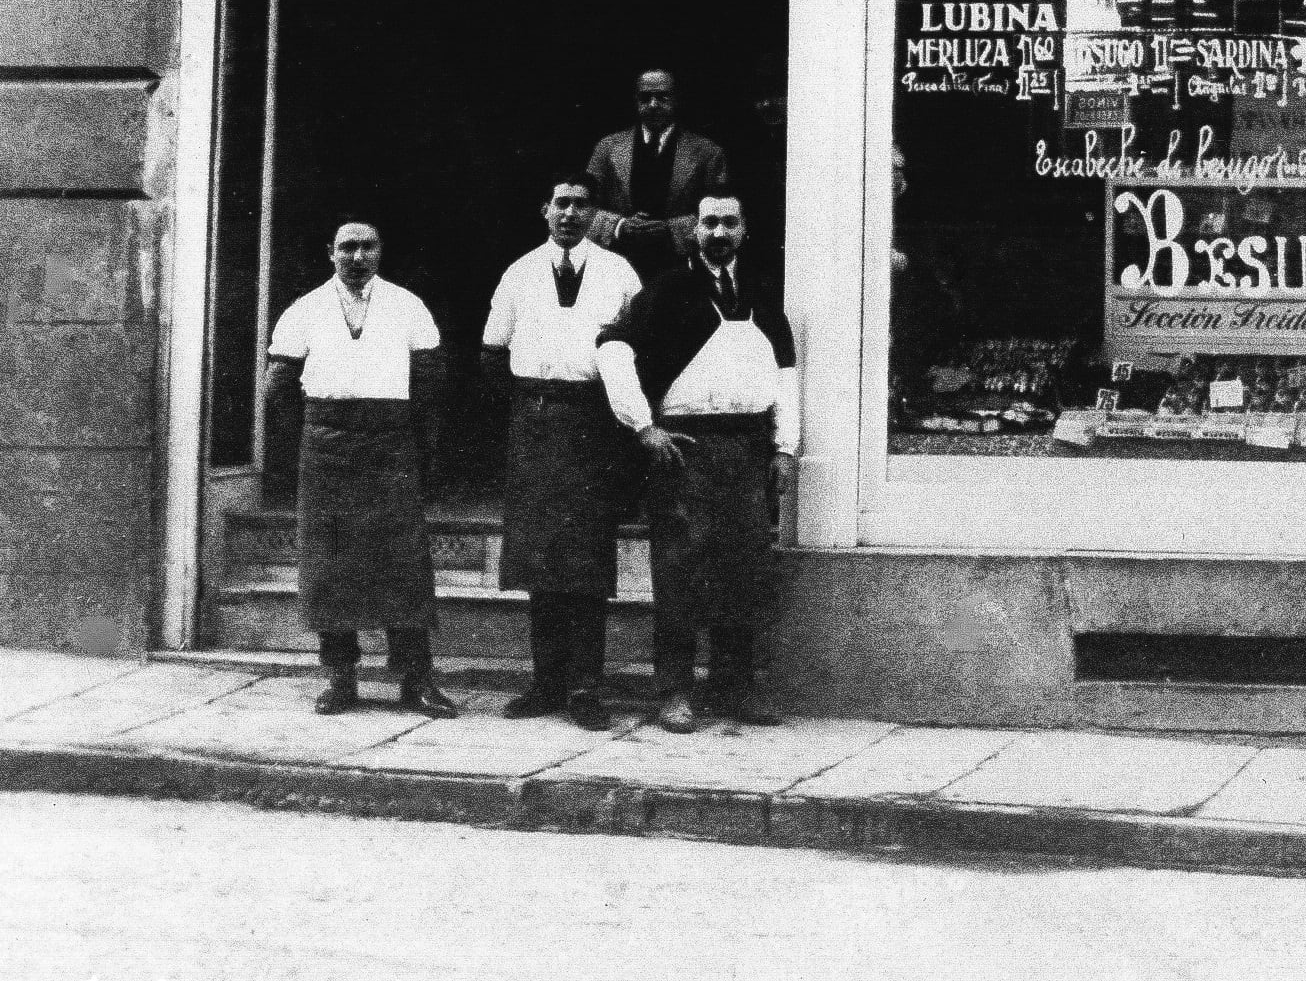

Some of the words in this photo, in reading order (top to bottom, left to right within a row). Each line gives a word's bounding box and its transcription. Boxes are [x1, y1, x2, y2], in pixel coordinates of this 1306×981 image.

[921, 3, 1059, 32] LUBINA
[906, 39, 1010, 68] MERLUZA
[1196, 39, 1288, 70] SARDINA
